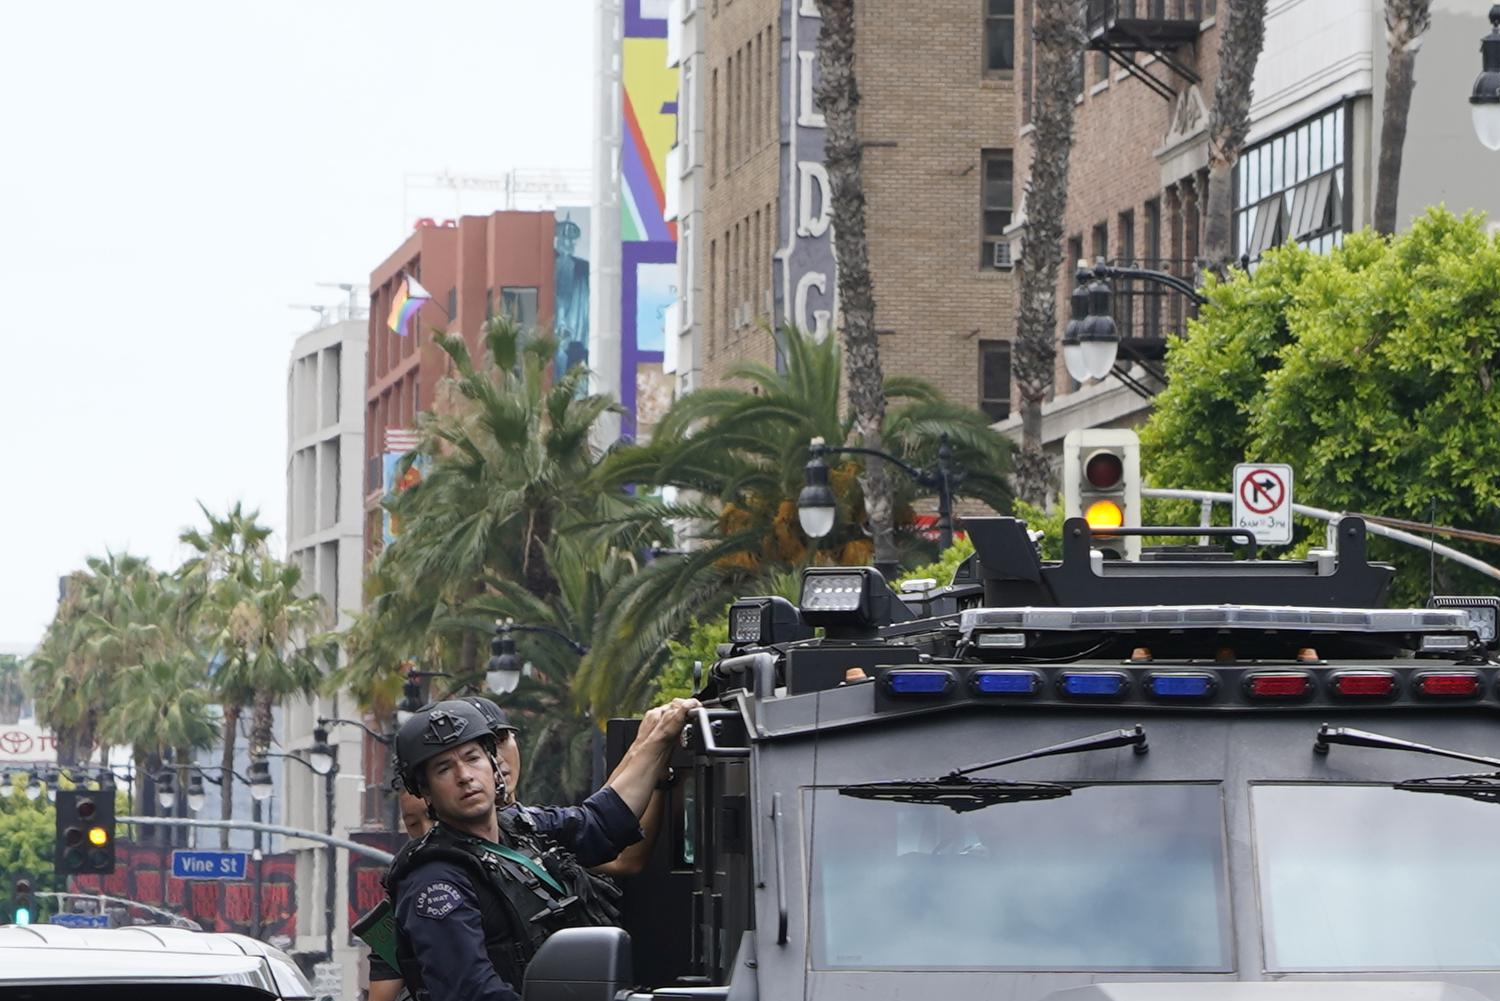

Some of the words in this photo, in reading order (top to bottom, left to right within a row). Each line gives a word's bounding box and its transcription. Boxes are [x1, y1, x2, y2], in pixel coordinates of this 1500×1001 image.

[181, 856, 214, 873] Vine
[219, 857, 238, 873] St
[426, 882, 461, 901] ANGELES
[426, 901, 454, 916] POLICE
